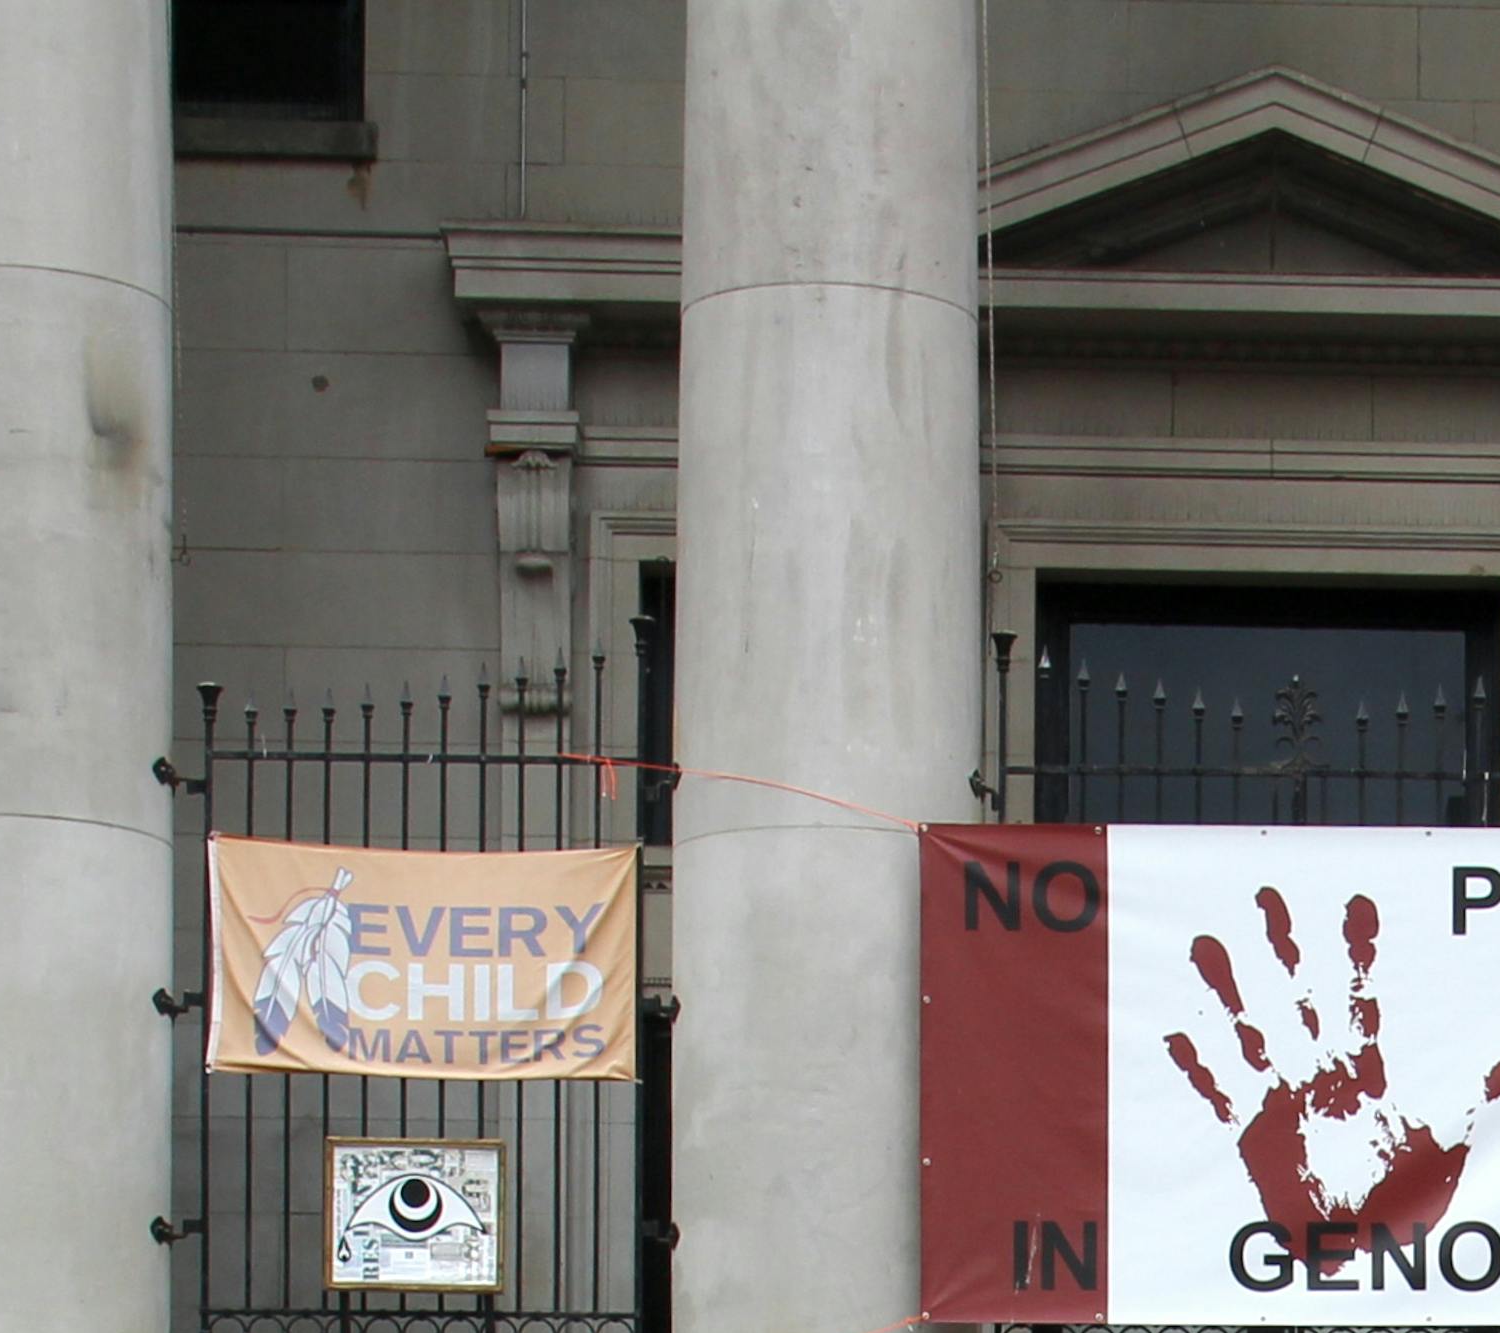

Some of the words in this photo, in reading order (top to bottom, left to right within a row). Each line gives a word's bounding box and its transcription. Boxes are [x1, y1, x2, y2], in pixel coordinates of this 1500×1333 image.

[964, 860, 1099, 931] NO
[348, 903, 604, 957] EVERY
[345, 960, 603, 1022] CHILD
[349, 1024, 606, 1065] MATTERS
[1012, 1221, 1098, 1292] IN
